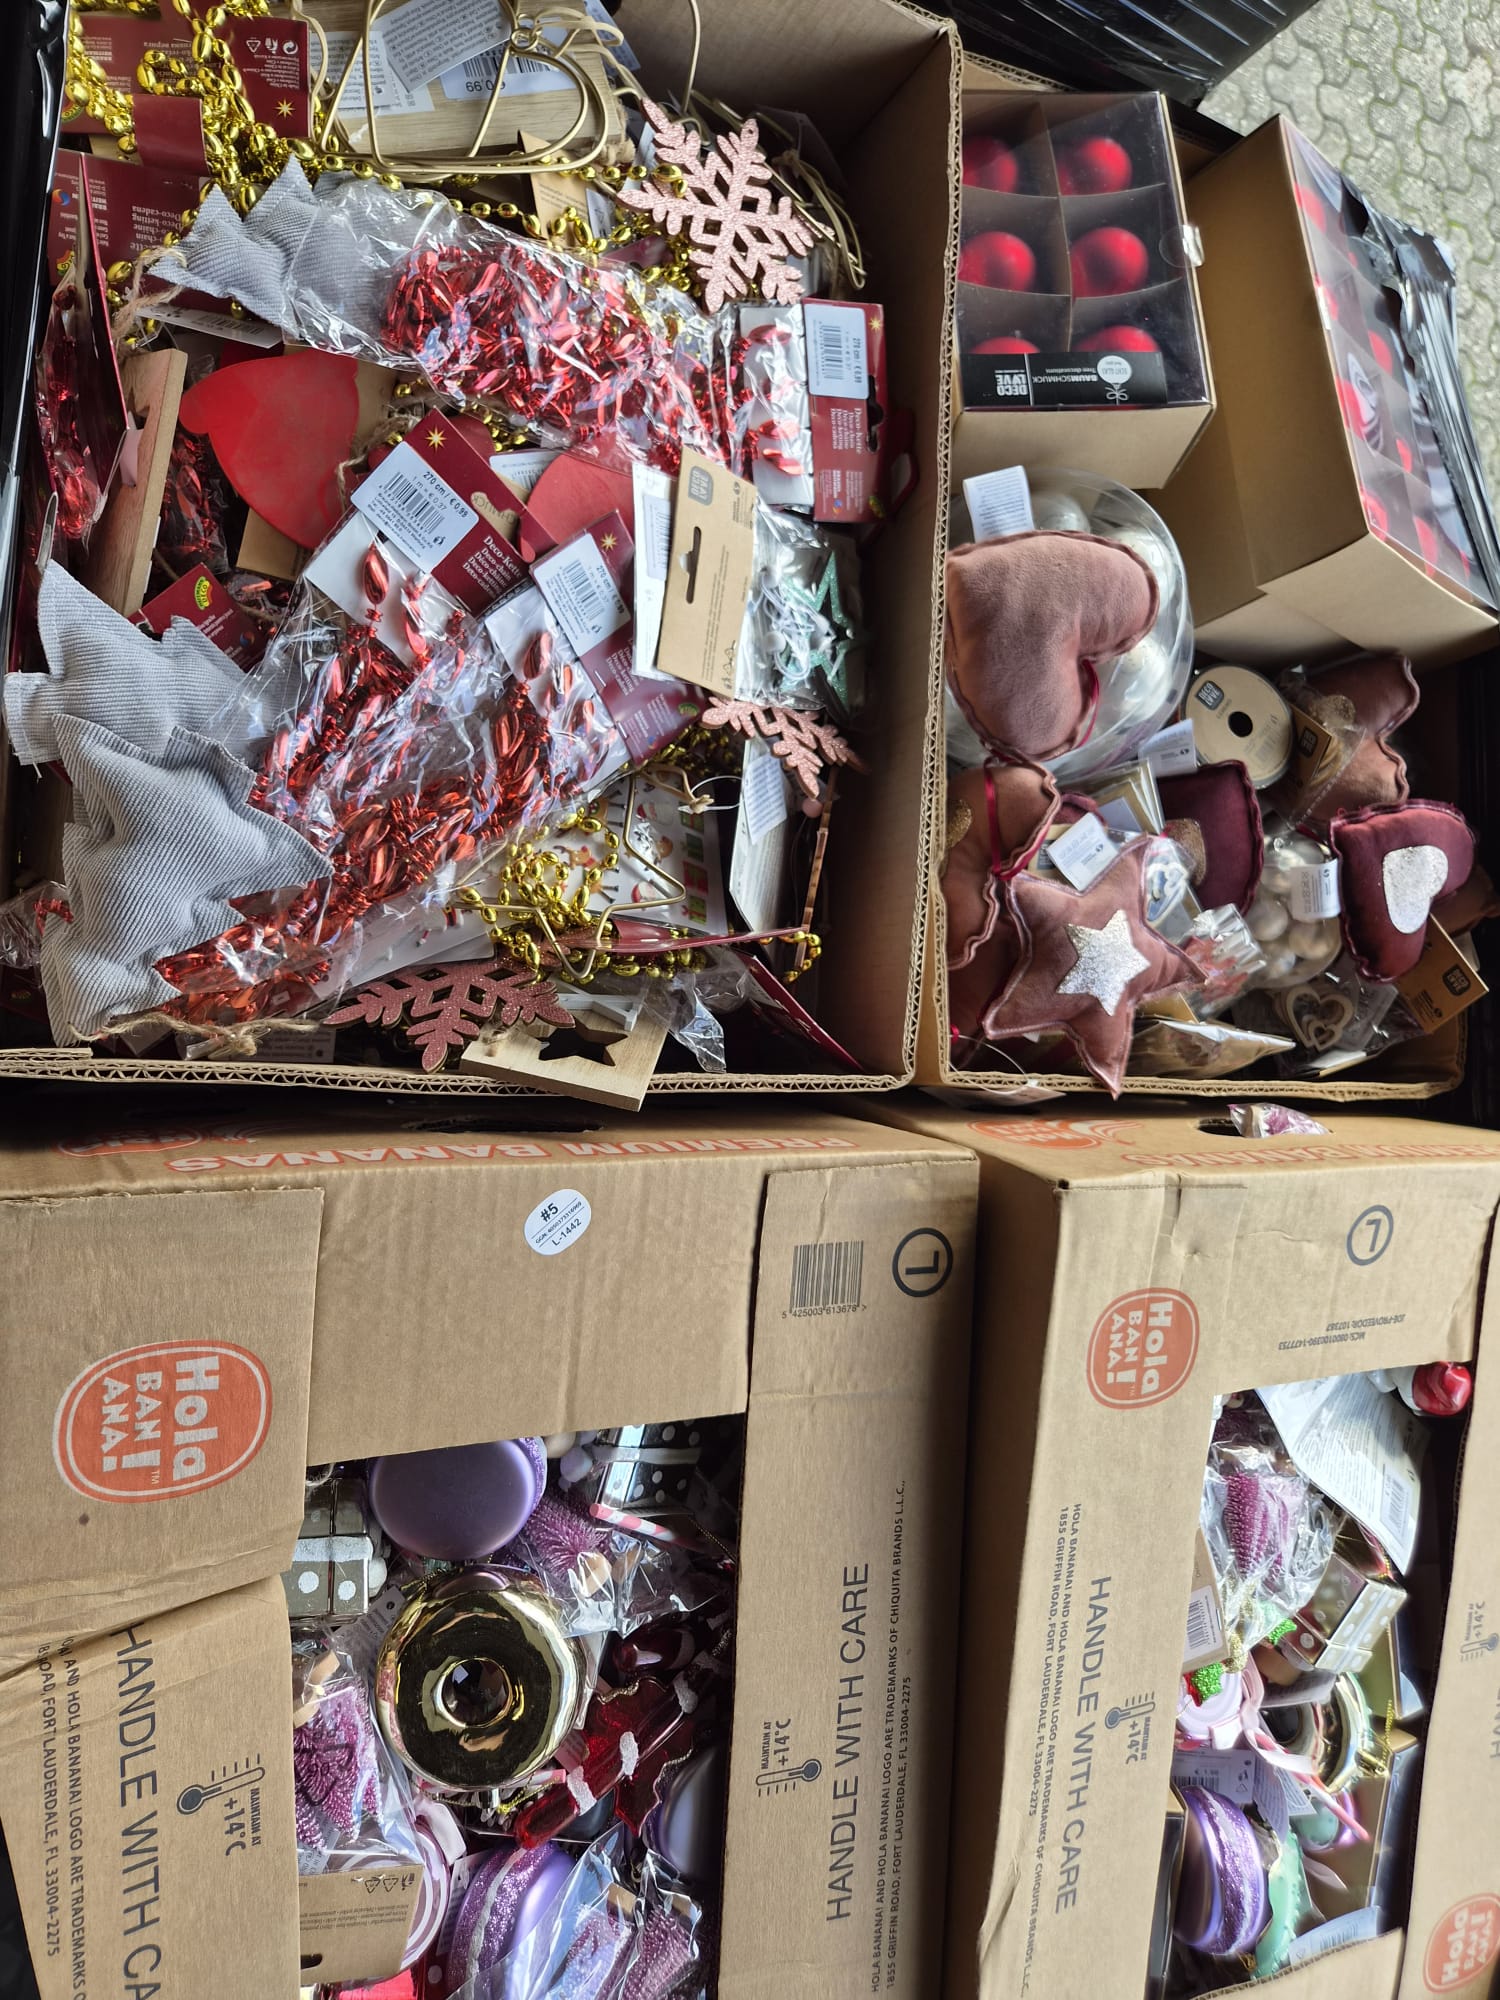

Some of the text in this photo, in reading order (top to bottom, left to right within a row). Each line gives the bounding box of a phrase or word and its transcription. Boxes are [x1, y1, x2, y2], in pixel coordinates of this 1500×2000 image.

[130, 205, 181, 221] Deco-cadena
[996, 384, 1027, 395] DECO
[1032, 373, 1097, 382] BAUMSCHMUCK
[422, 470, 437, 485] 270
[433, 482, 446, 495] cm
[447, 497, 456, 506] €
[451, 501, 469, 519] 0,99
[479, 547, 515, 581] Deco-chain
[481, 535, 526, 578] Deco-Kette
[165, 1141, 552, 1173] BANANAS
[559, 1137, 860, 1158] PREMIUM
[537, 1201, 560, 1223] #5
[551, 1217, 581, 1245] L-1442
[791, 1306, 822, 1318] 425003
[1140, 1300, 1173, 1396] Hola
[173, 1355, 220, 1482] Hola
[1058, 1506, 1069, 1534] 1855
[1071, 1503, 1082, 1535] HOLA
[892, 1517, 904, 1566] BRANDS
[1053, 1536, 1066, 1581] GRIFFIN
[890, 1568, 902, 1624] CHIQUITA
[1062, 1593, 1072, 1618] AND
[889, 1627, 898, 1644] OF
[1045, 1623, 1056, 1653] FORT
[1057, 1620, 1069, 1653] HOLA
[64, 1659, 80, 1686] AND
[884, 1646, 898, 1725] TRADEMARKS
[67, 1690, 81, 1731] HOLA
[899, 1677, 911, 1744] 33004-2275
[1036, 1655, 1052, 1733] LAUDERDALE,
[42, 1699, 56, 1734] FORT
[109, 1622, 158, 1807] HANDLE
[1048, 1709, 1059, 1741] LOGO
[760, 1721, 771, 1770] MAINTAIN AT
[773, 1718, 792, 1766] +14°C
[826, 1563, 869, 1921] HANDLE WITH CARE
[883, 1726, 894, 1749] ARE
[899, 1746, 908, 1759] FL
[1035, 1735, 1045, 1749] FL
[1054, 1576, 1112, 1915] HANDLE WITH CARE
[882, 1752, 893, 1785] LOGO
[1046, 1744, 1056, 1767] ARE
[42, 1738, 58, 1844] LAUDERDALE,
[1029, 1751, 1043, 1817] 33004-2275
[250, 1788, 261, 1846] MAINTAIN AT
[894, 1761, 908, 1842] LAUDERDALE,
[1037, 1767, 1053, 1843] TRADEMARKS
[69, 1808, 83, 1850] LOGO
[224, 1798, 247, 1856] +14°C
[45, 1847, 59, 1865] FL
[876, 1843, 887, 1876] HOLA
[892, 1845, 903, 1874] FORT
[1035, 1845, 1045, 1860] OF
[70, 1856, 83, 1885] ARE
[122, 1811, 161, 1936] WITH
[876, 1878, 885, 1903] AND
[1030, 1863, 1043, 1915] CHIQUITA
[45, 1869, 60, 1957] 33004-2275
[70, 1886, 86, 1989] TRADEMARKS
[888, 1916, 900, 1959] GRIFFIN
[1439, 1903, 1470, 1986] Hola
[871, 1961, 881, 1992] HOLA
[886, 1961, 897, 1988] 1855
